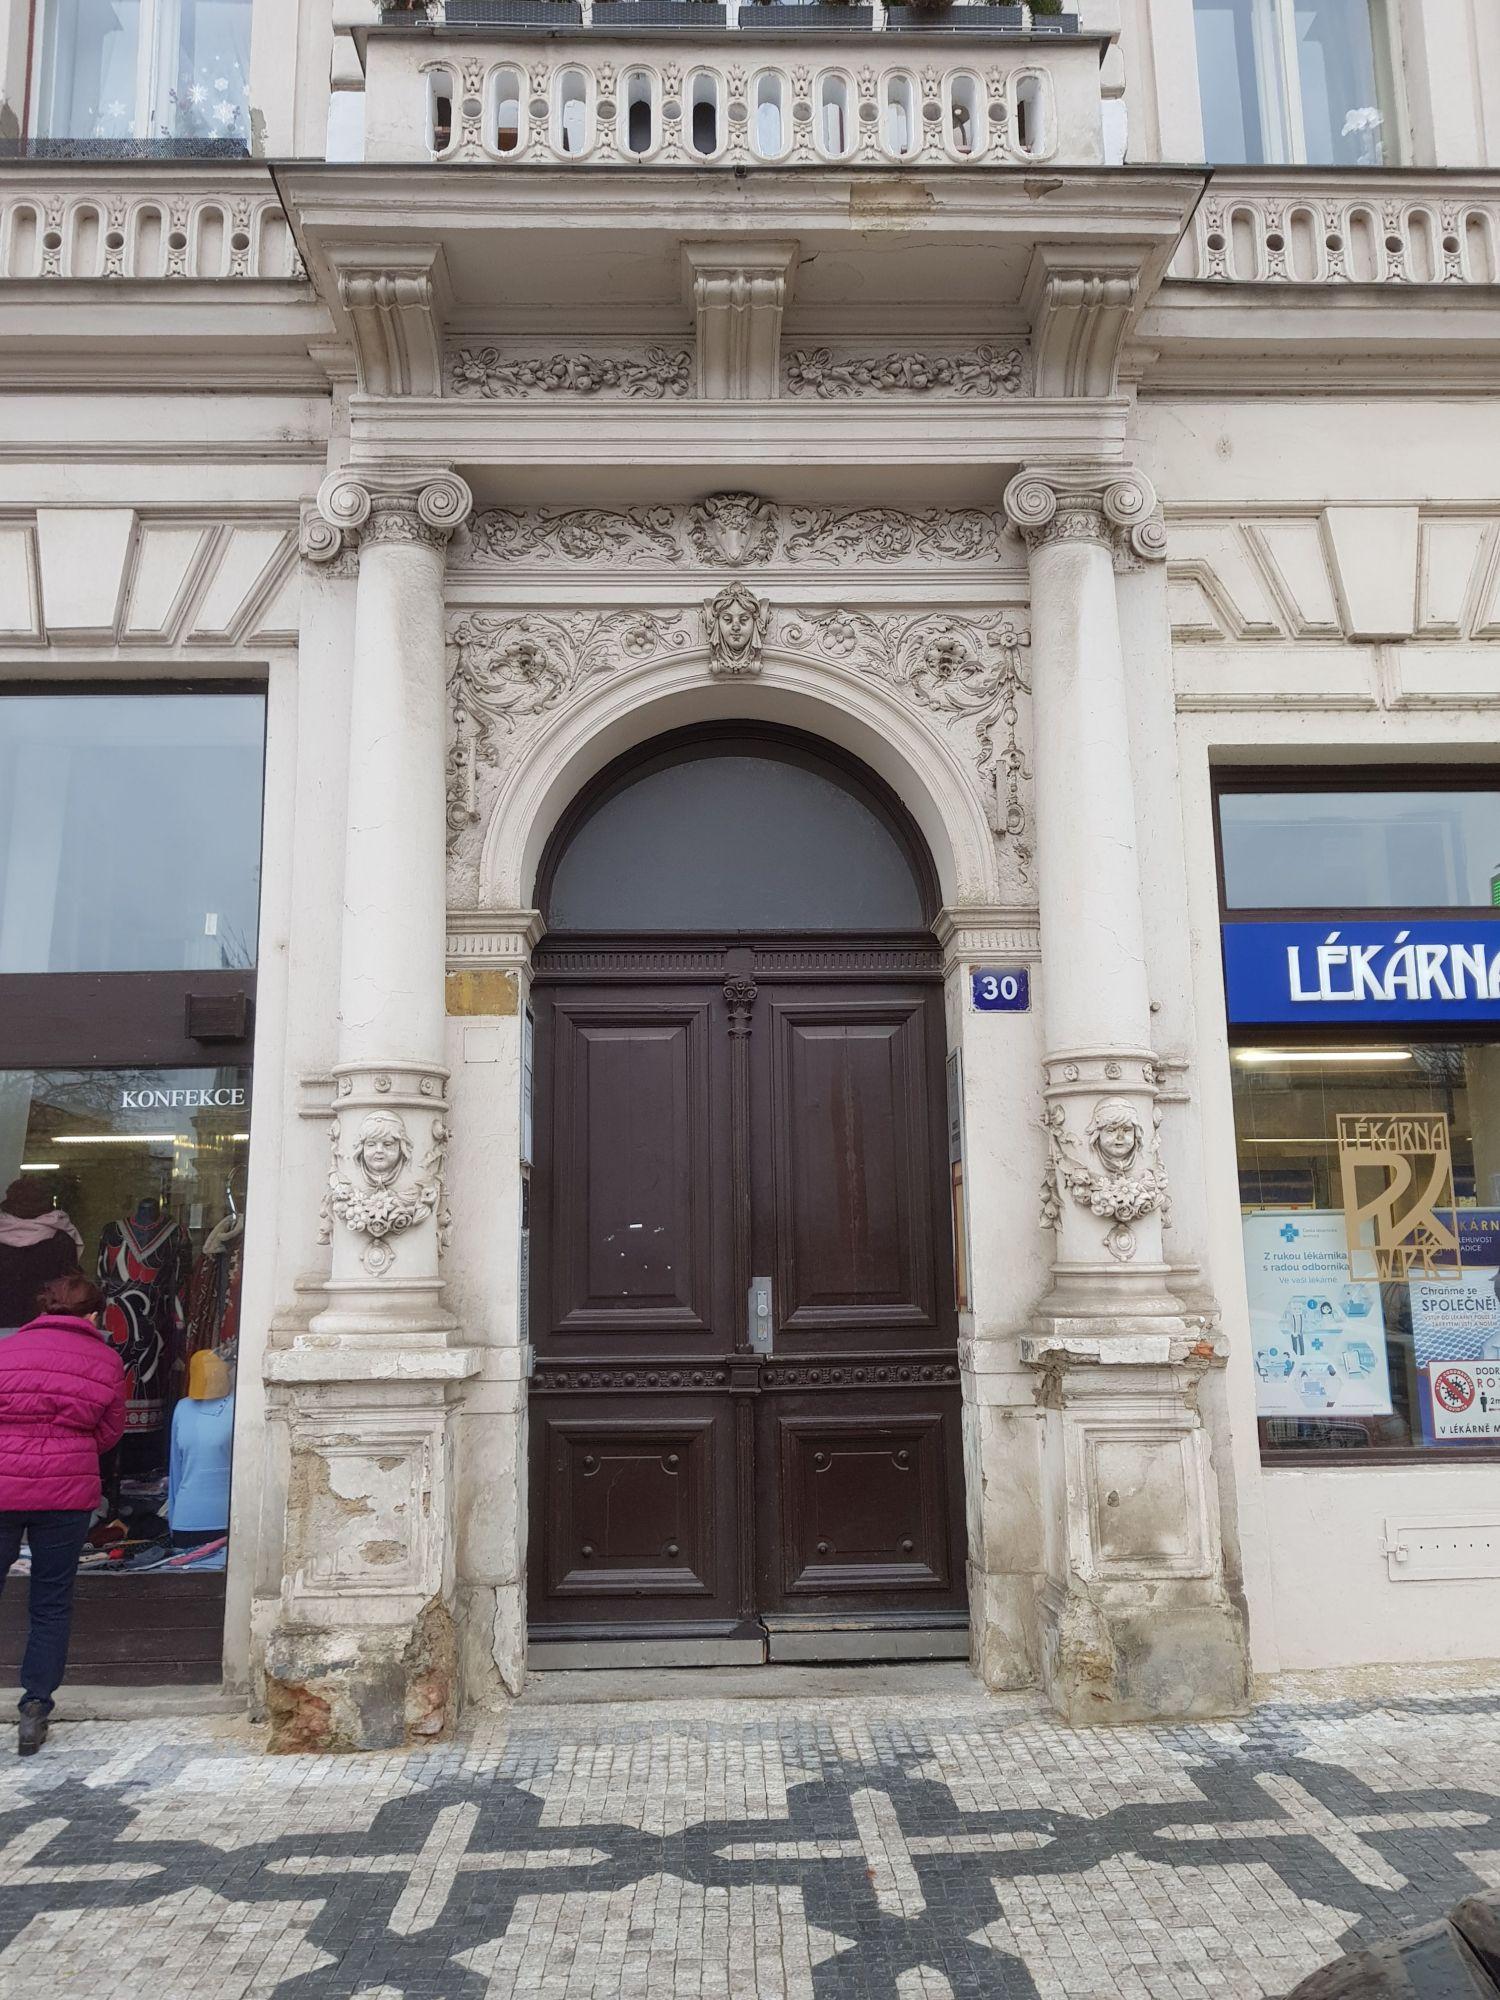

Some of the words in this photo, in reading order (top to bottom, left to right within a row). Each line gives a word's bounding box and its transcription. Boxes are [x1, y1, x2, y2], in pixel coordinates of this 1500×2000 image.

[981, 975, 1018, 1000] 30
[121, 1088, 245, 1108] KONFEKCE
[1341, 1117, 1445, 1150] LÉKÁRNA
[1453, 1217, 1500, 1231] KÁRN
[1263, 1252, 1271, 1260] Z
[1273, 1252, 1301, 1261] rukou
[1271, 1263, 1299, 1271] radou
[1422, 1296, 1497, 1311] SPOLEČNĚ!
[1477, 1378, 1500, 1388] RO
[1440, 1426, 1446, 1434] V
